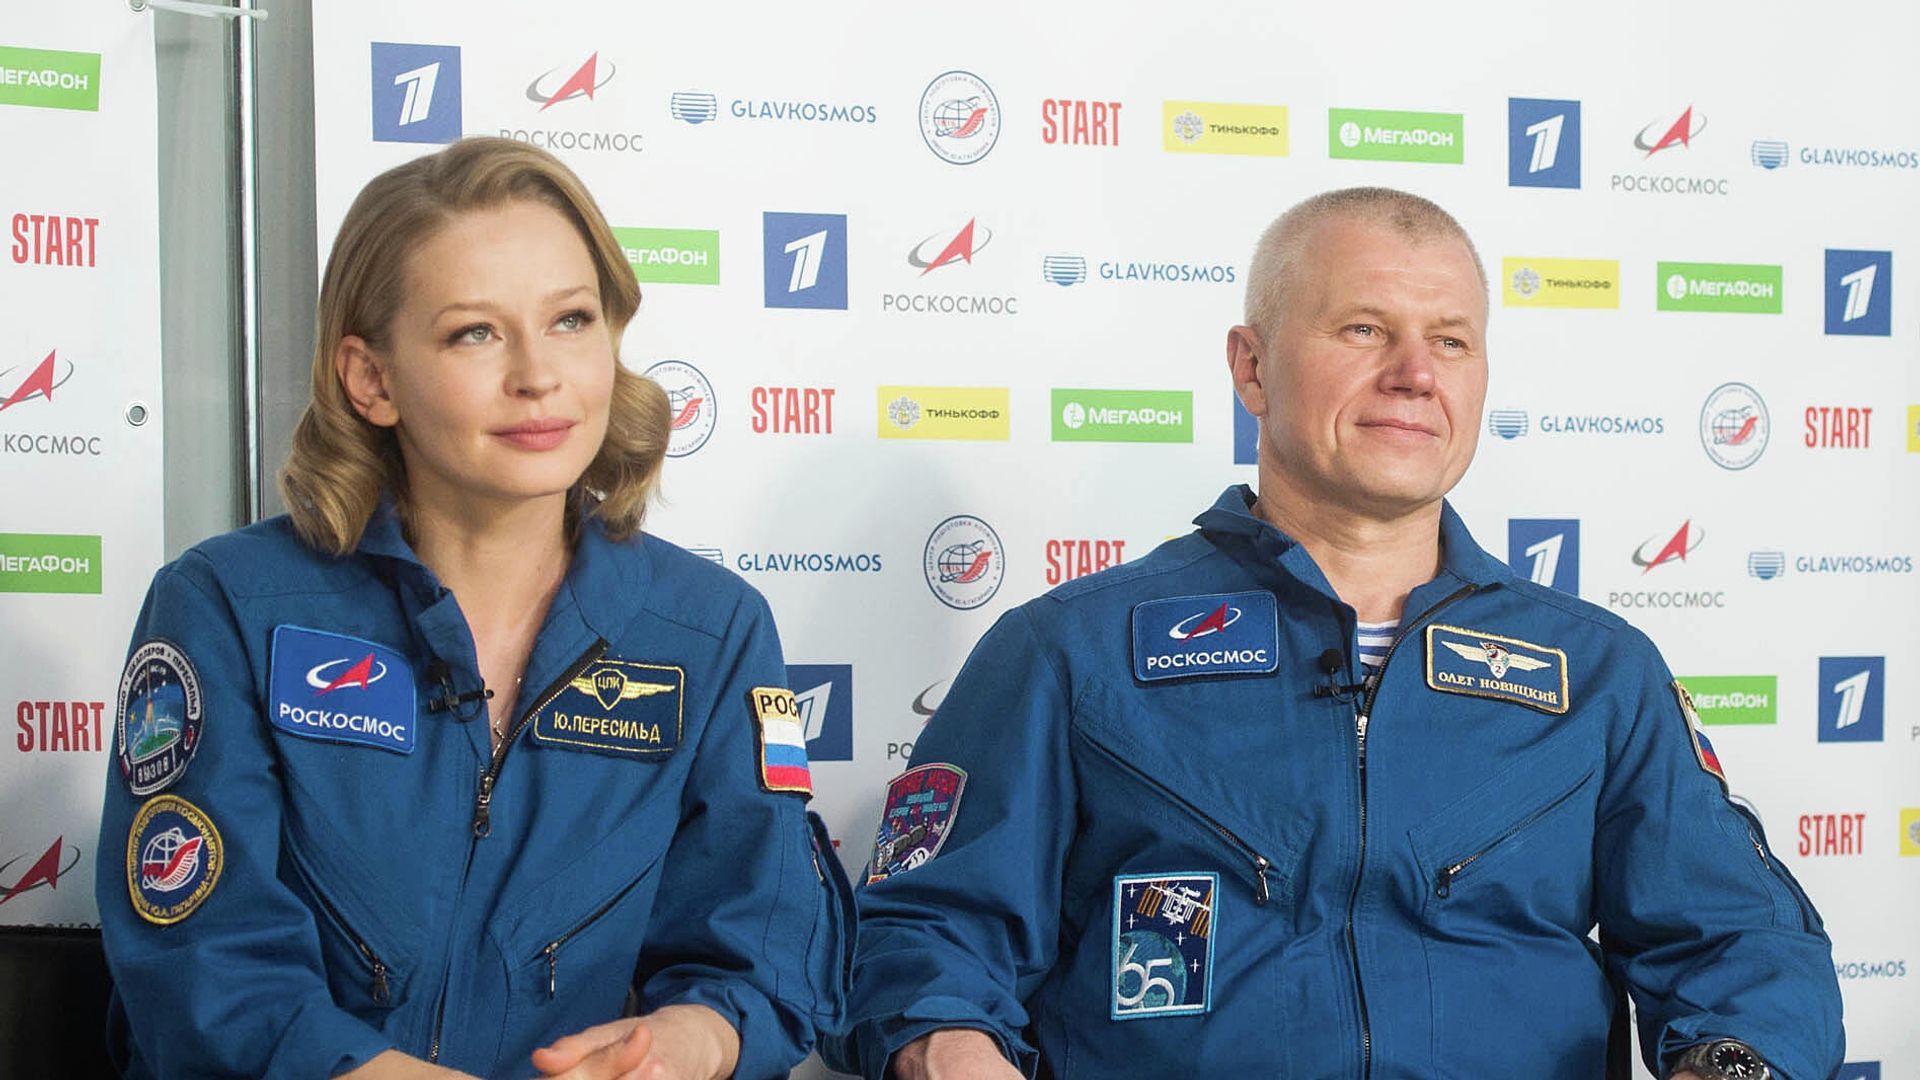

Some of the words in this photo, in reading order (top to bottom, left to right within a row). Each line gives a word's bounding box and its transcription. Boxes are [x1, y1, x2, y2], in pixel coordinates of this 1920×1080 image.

[731, 99, 877, 123] GLAVKOSMOS
[1042, 98, 1123, 147] START
[1208, 124, 1281, 136] ТИНЬКОФФ
[1800, 147, 1919, 169] GLAVKOSMOS
[1611, 174, 1728, 196] РОСКОСМОС
[11, 213, 100, 268] START
[625, 247, 708, 266] ЕГАФОН
[1099, 262, 1235, 283] GLAVKOSMOS
[883, 293, 1018, 315] РОСКОСМОС
[751, 386, 836, 435] START
[926, 408, 1000, 420] ТИНЬКОФФ
[1540, 415, 1664, 434] GLAVKOSMOS
[1804, 406, 1873, 449] START
[4, 433, 101, 456] КОСМОС
[737, 553, 883, 572] GLAVKOSMOS
[1046, 539, 1126, 585] START
[1796, 556, 1912, 573] GLAVKOSMOS
[1609, 592, 1725, 608] РОСКОСМОС
[1147, 649, 1267, 670] РОСКОСМОС
[598, 677, 620, 690] ЦПК
[1438, 672, 1475, 686] ОЛЕГ
[1479, 678, 1558, 704] НОВИЦКИЙ
[16, 700, 105, 753] START
[279, 702, 406, 741] РОСКОСМОС
[553, 710, 661, 744] Ю.ПЕРЕСИЛЬД
[1798, 814, 1866, 857] START
[1117, 943, 1175, 1010] 65
